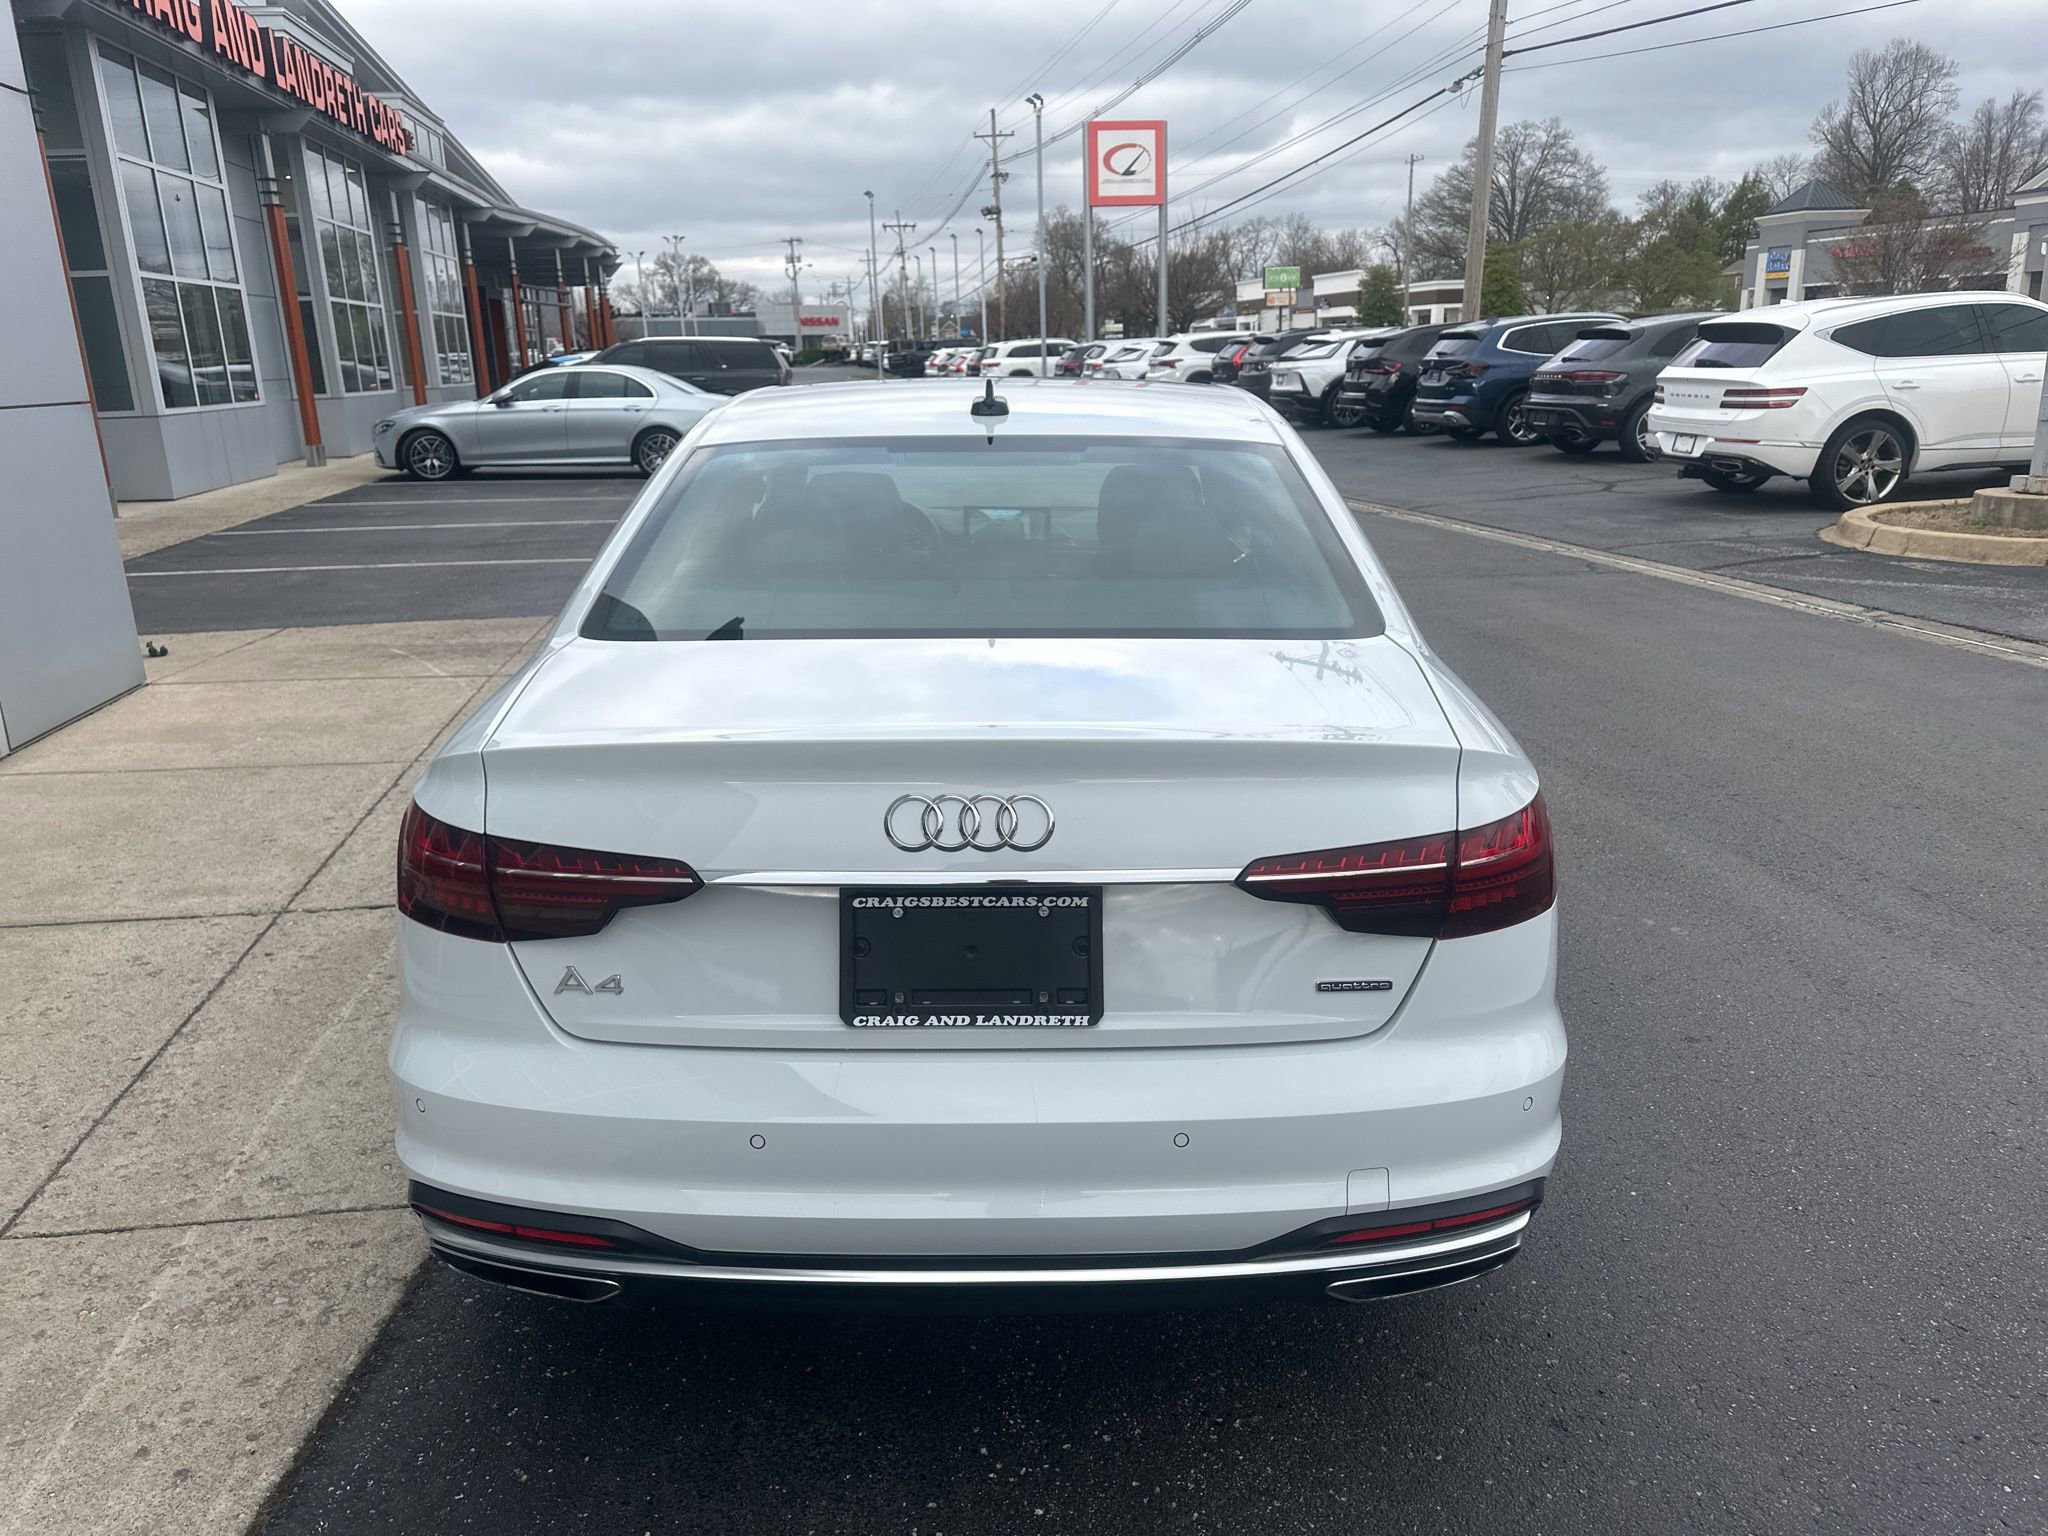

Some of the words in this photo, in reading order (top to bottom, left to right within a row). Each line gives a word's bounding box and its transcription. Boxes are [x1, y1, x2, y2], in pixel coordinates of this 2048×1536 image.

[210, 0, 266, 78] AND
[268, 27, 369, 136] LANDRETH
[367, 93, 407, 156] CARS
[800, 316, 839, 327] NISSAN
[852, 896, 1089, 908] CRAIGSBESTCARS.COM
[554, 965, 624, 995] A4
[1320, 982, 1390, 991] quattro
[853, 1015, 920, 1027] CRAIG
[924, 1015, 971, 1026] AND
[975, 1015, 1090, 1026] LANDRETH
